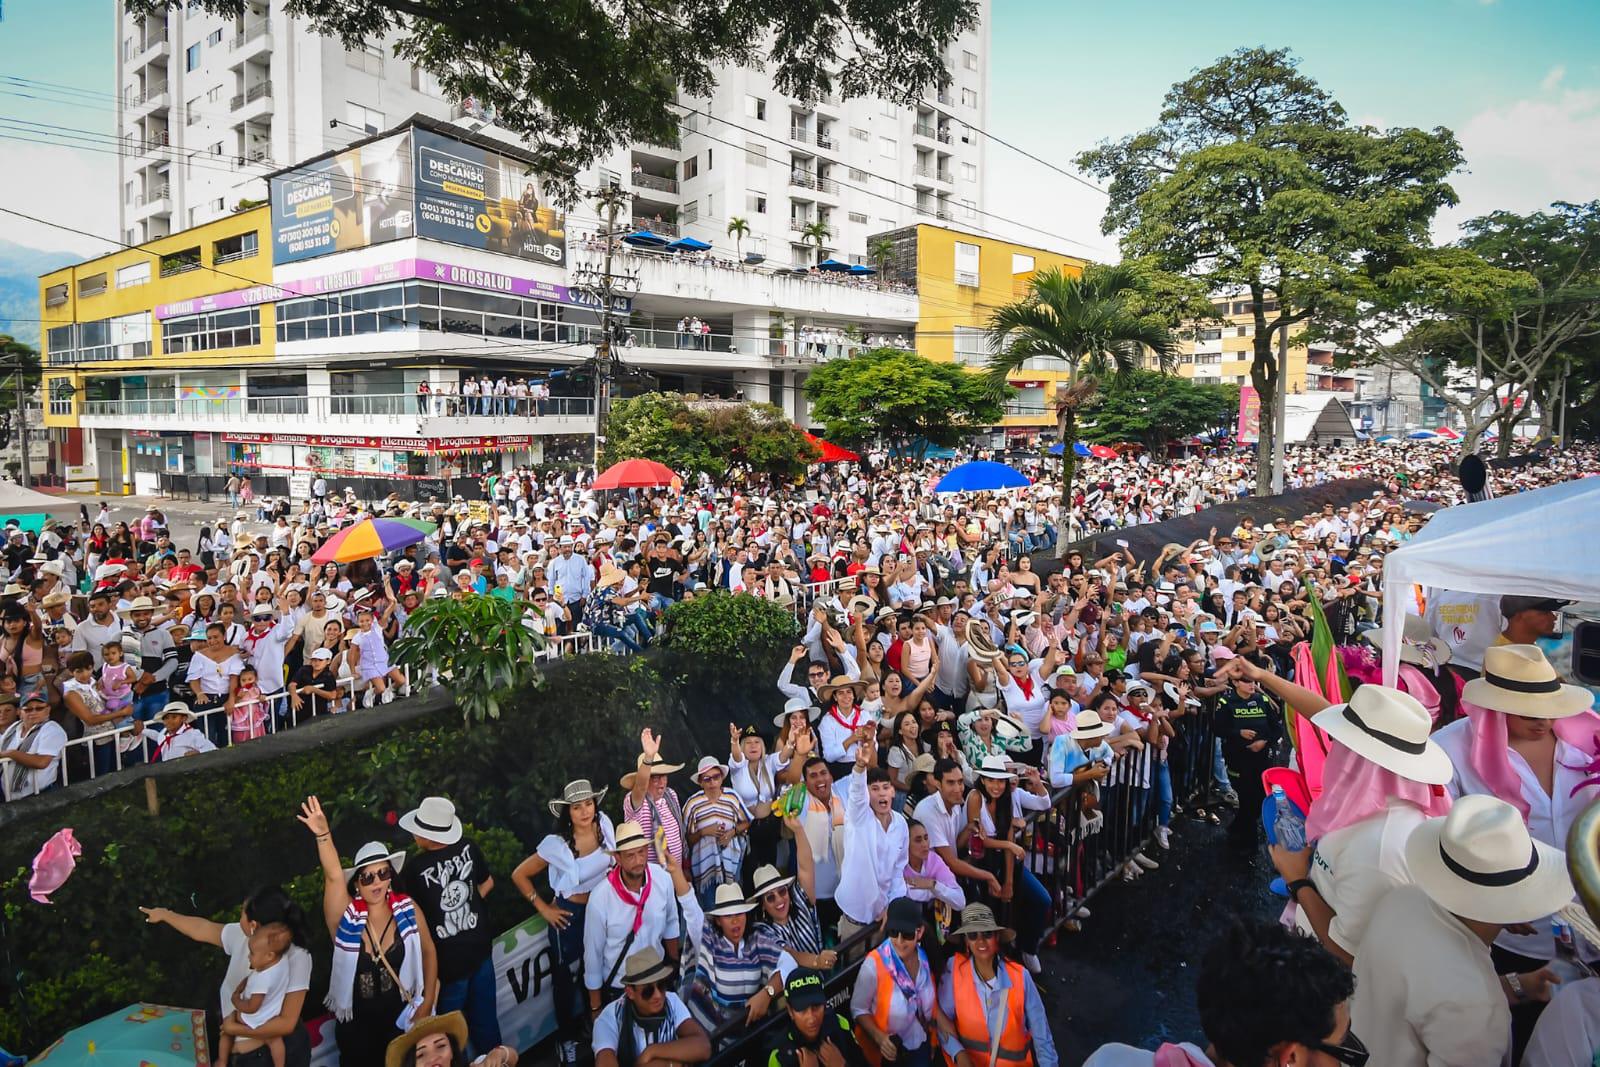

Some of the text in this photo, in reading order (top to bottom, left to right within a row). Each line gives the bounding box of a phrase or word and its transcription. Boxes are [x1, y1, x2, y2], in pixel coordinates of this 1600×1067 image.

[429, 159, 484, 183] DESCANSO
[287, 181, 331, 206] DESCANSO
[419, 202, 474, 221] (301) 200 96 10
[421, 211, 443, 223] (608)
[523, 243, 544, 255] HOTEL
[451, 267, 512, 291] OROSALUD
[380, 437, 428, 447] Alemana
[789, 974, 820, 990] POLICÍA
[826, 986, 850, 1009] ESTIVAL
